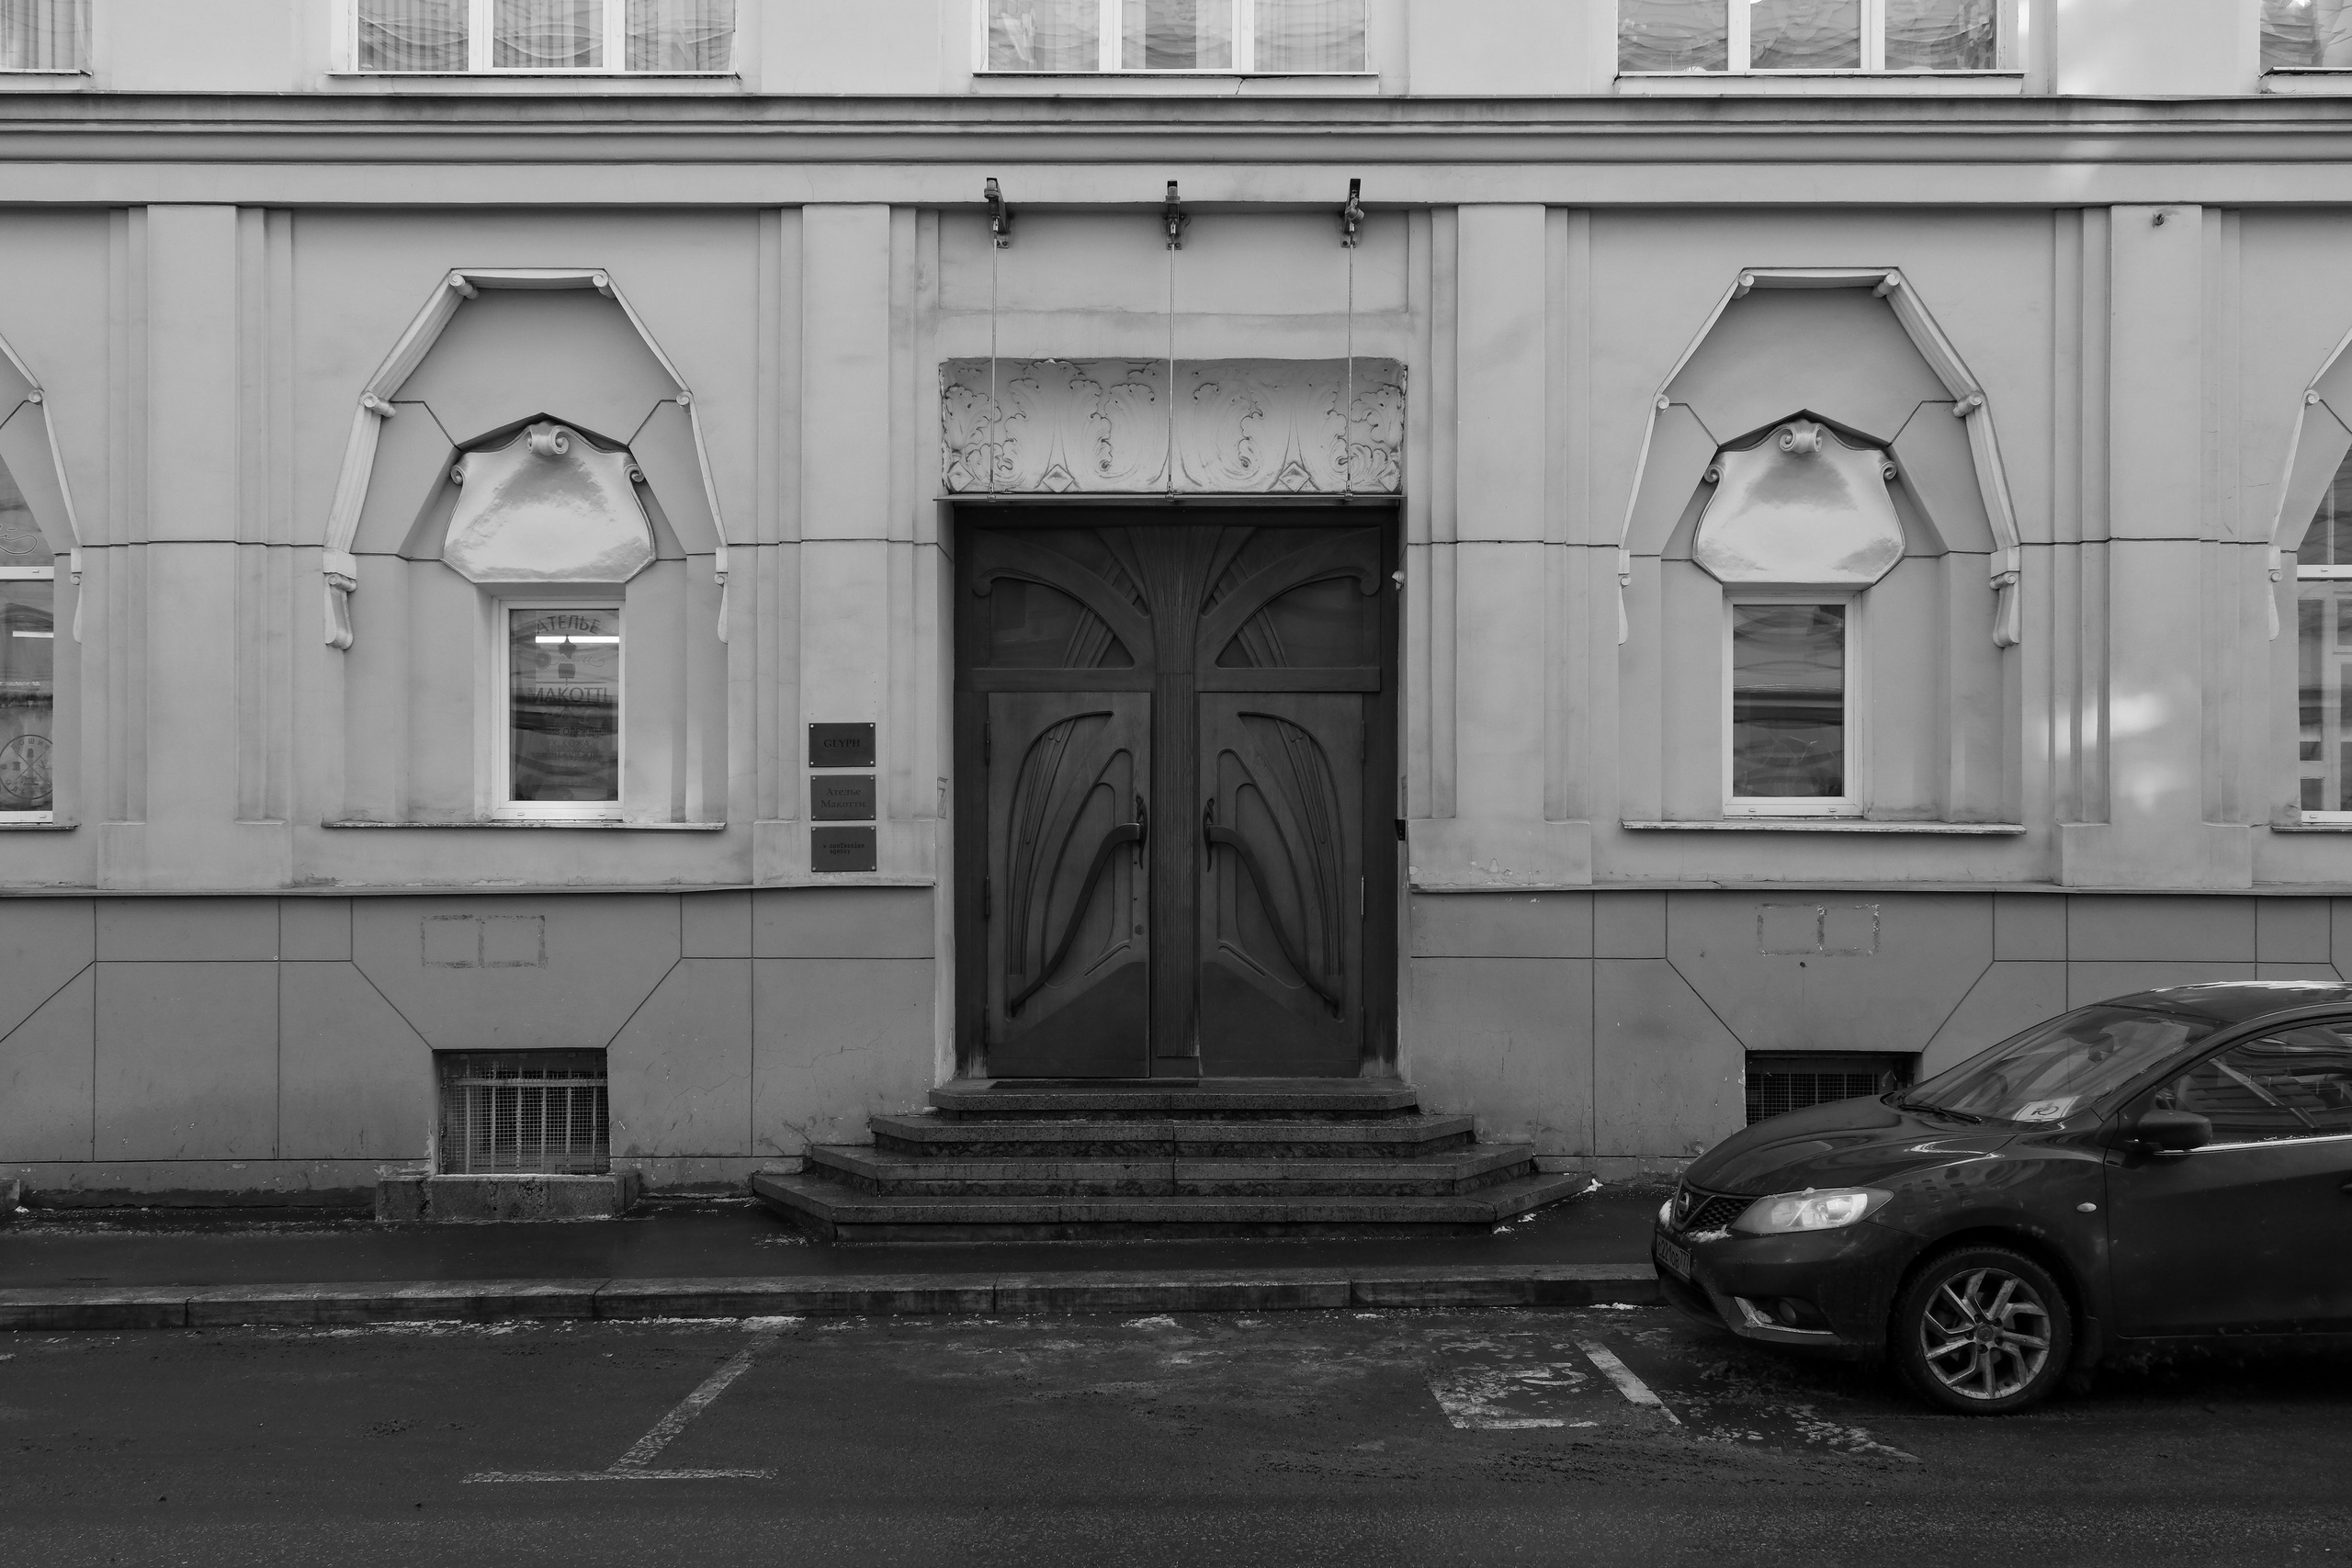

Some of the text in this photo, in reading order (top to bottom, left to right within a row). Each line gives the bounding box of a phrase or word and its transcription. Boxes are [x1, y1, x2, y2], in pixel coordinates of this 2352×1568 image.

[537, 615, 602, 635] АТЕЛЬЕ
[11, 738, 51, 751] ПОШИВ
[823, 739, 861, 749] GLYPH
[825, 787, 861, 796] Ателье
[820, 799, 866, 808] Макотти
